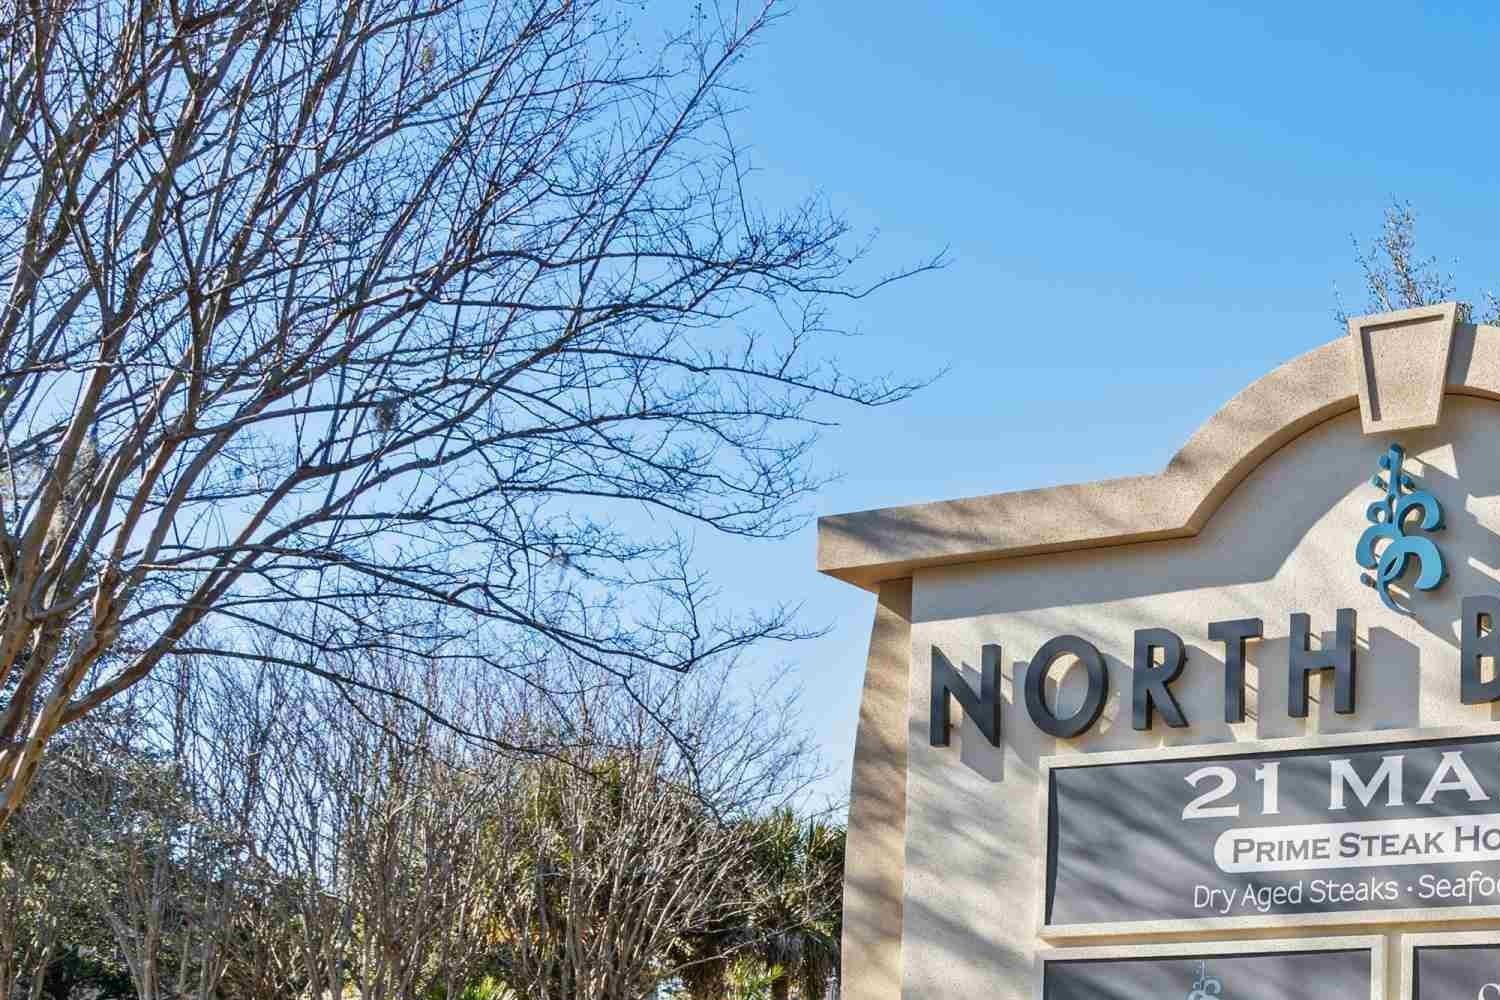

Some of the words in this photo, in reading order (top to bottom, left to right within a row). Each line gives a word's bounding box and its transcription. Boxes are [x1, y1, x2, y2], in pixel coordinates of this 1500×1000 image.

[930, 607, 1357, 747] NORTH
[1181, 762, 1281, 821] 21
[1232, 838, 1330, 864] PRIME
[1338, 830, 1445, 858] STEAK
[1193, 885, 1236, 913] Dry
[1241, 882, 1301, 912] Aged
[1309, 877, 1399, 903] Steaks
